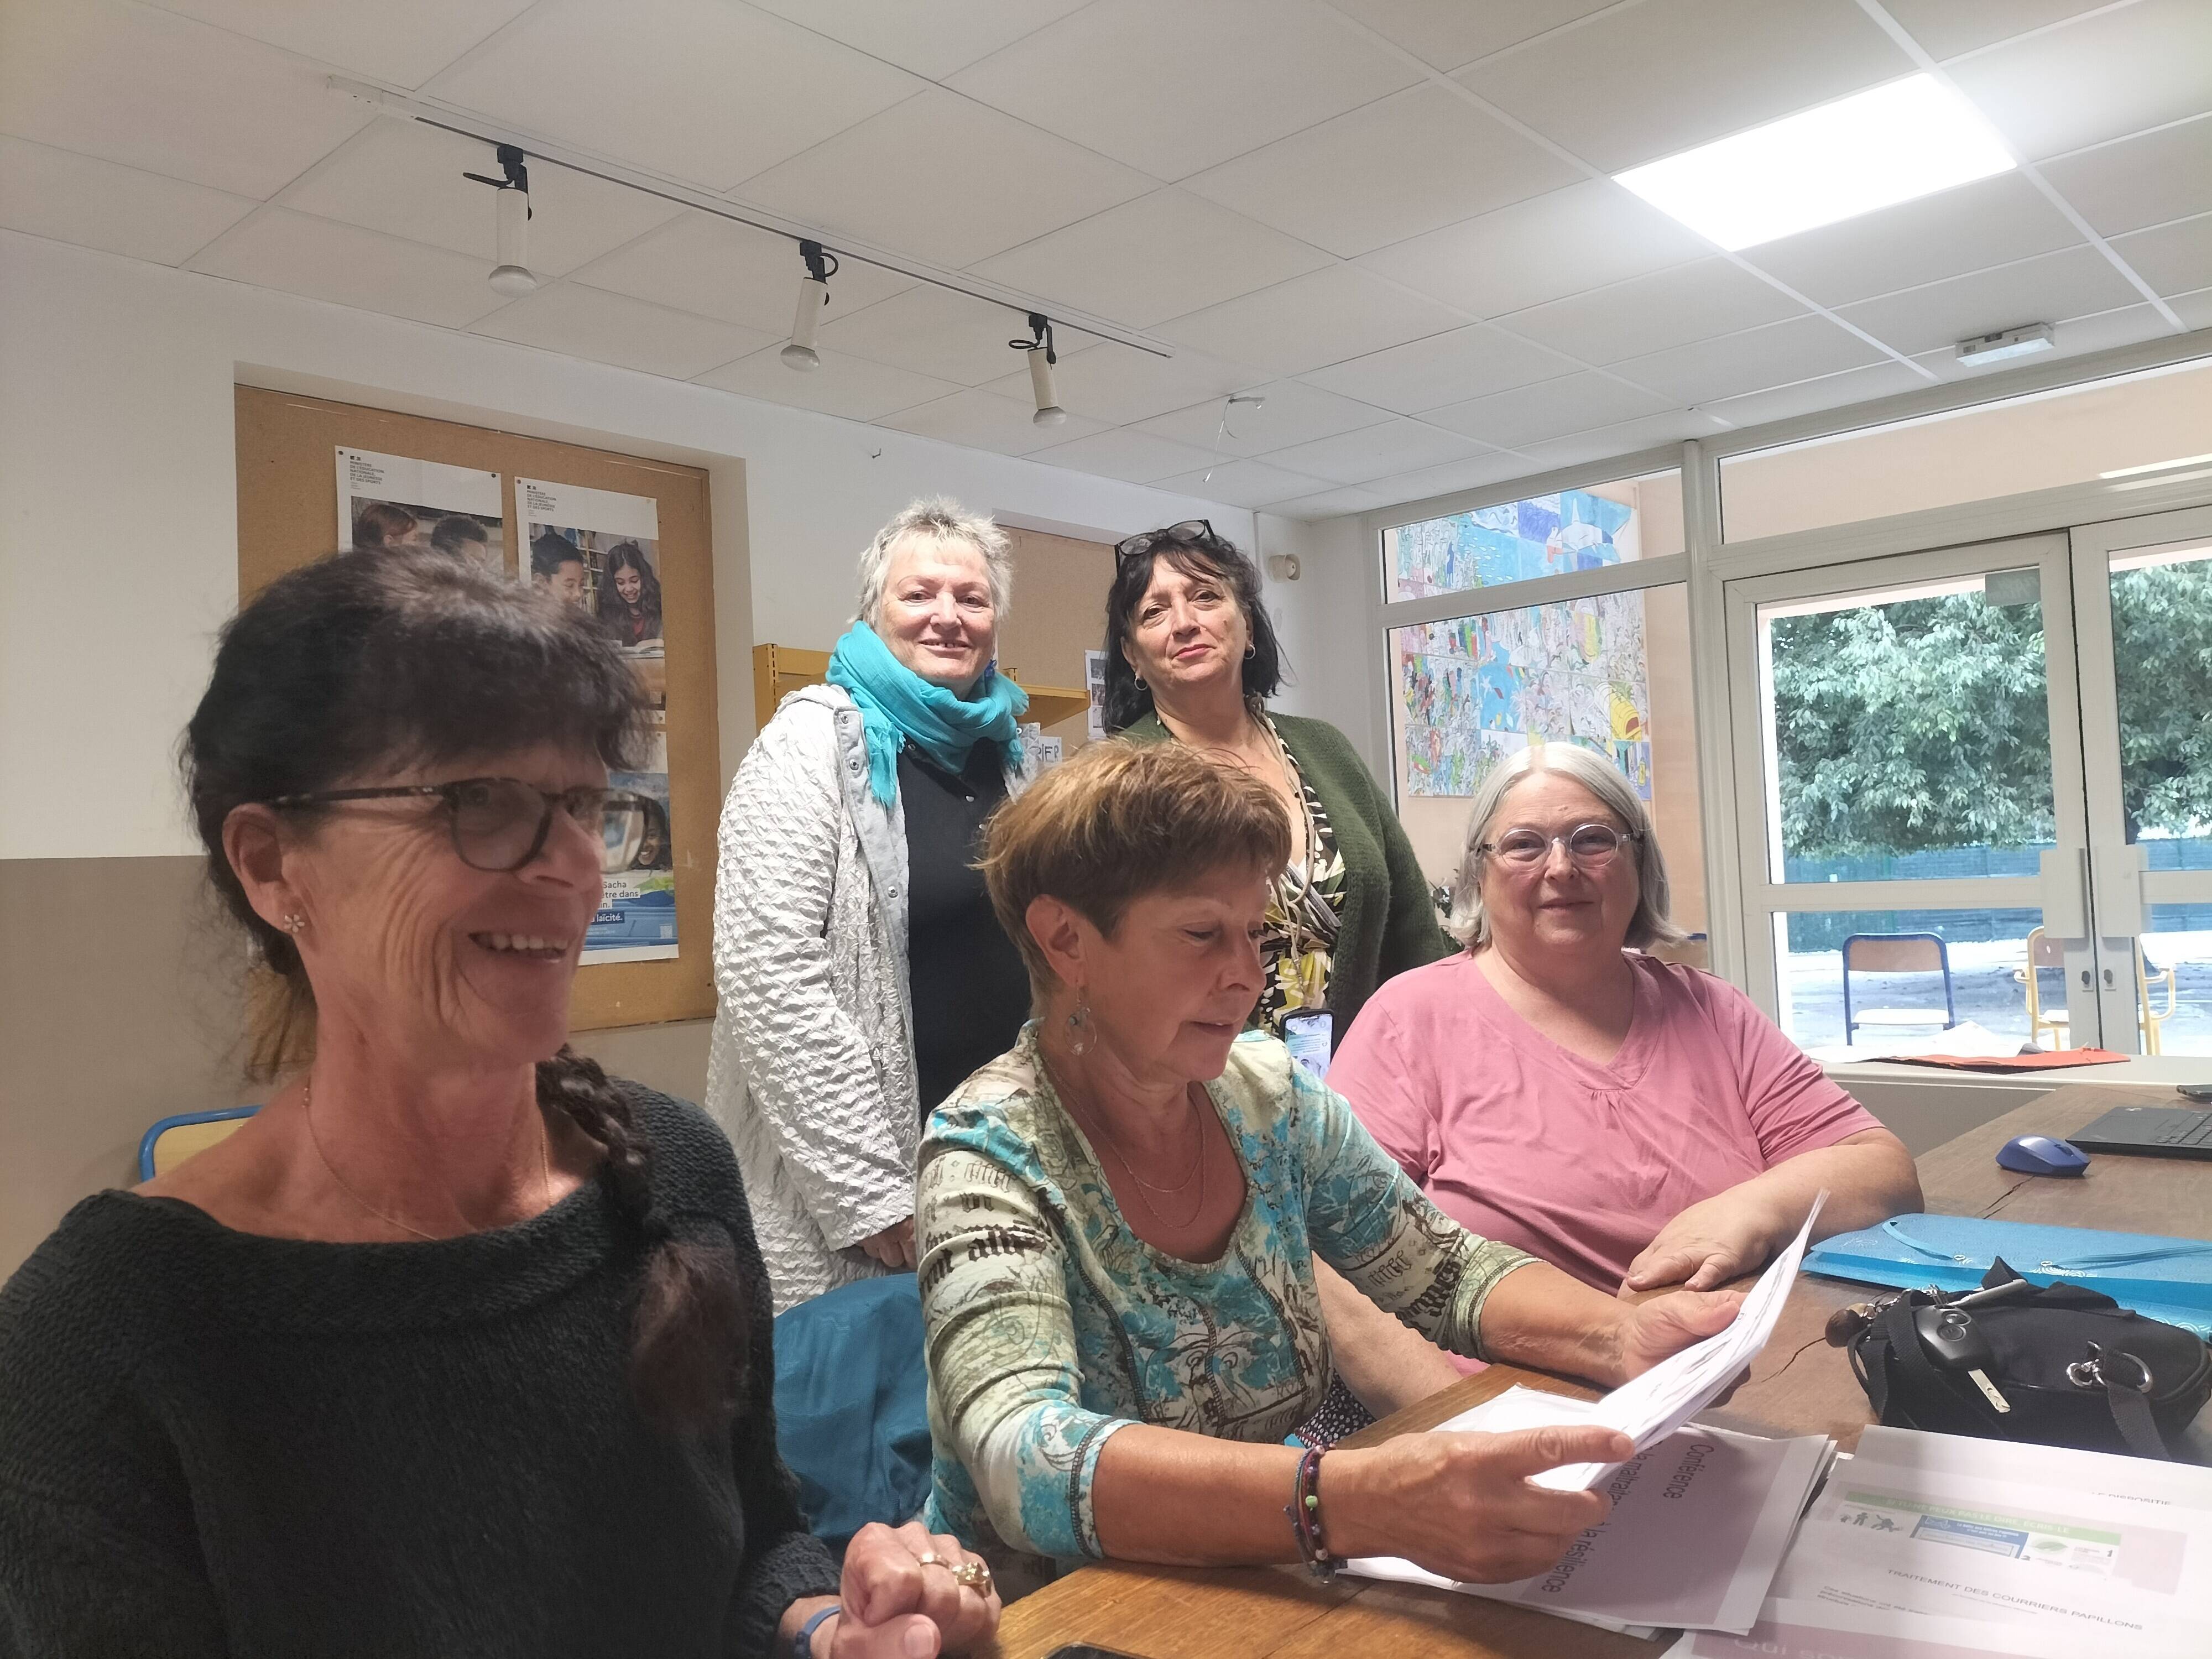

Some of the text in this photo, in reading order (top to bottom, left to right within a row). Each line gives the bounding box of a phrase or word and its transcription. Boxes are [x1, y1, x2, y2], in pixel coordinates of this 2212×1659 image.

[603, 880, 627, 889] Sacha
[597, 912, 623, 922] laïcité.
[1662, 1443, 1715, 1499] Conférence
[1541, 1539, 1596, 1593] résilience
[1887, 1568, 1962, 1590] TRAITEMENT
[1964, 1587, 1990, 1597] DES
[1992, 1592, 2068, 1615] COURRIERS
[2070, 1610, 2143, 1631] PAPILLONS
